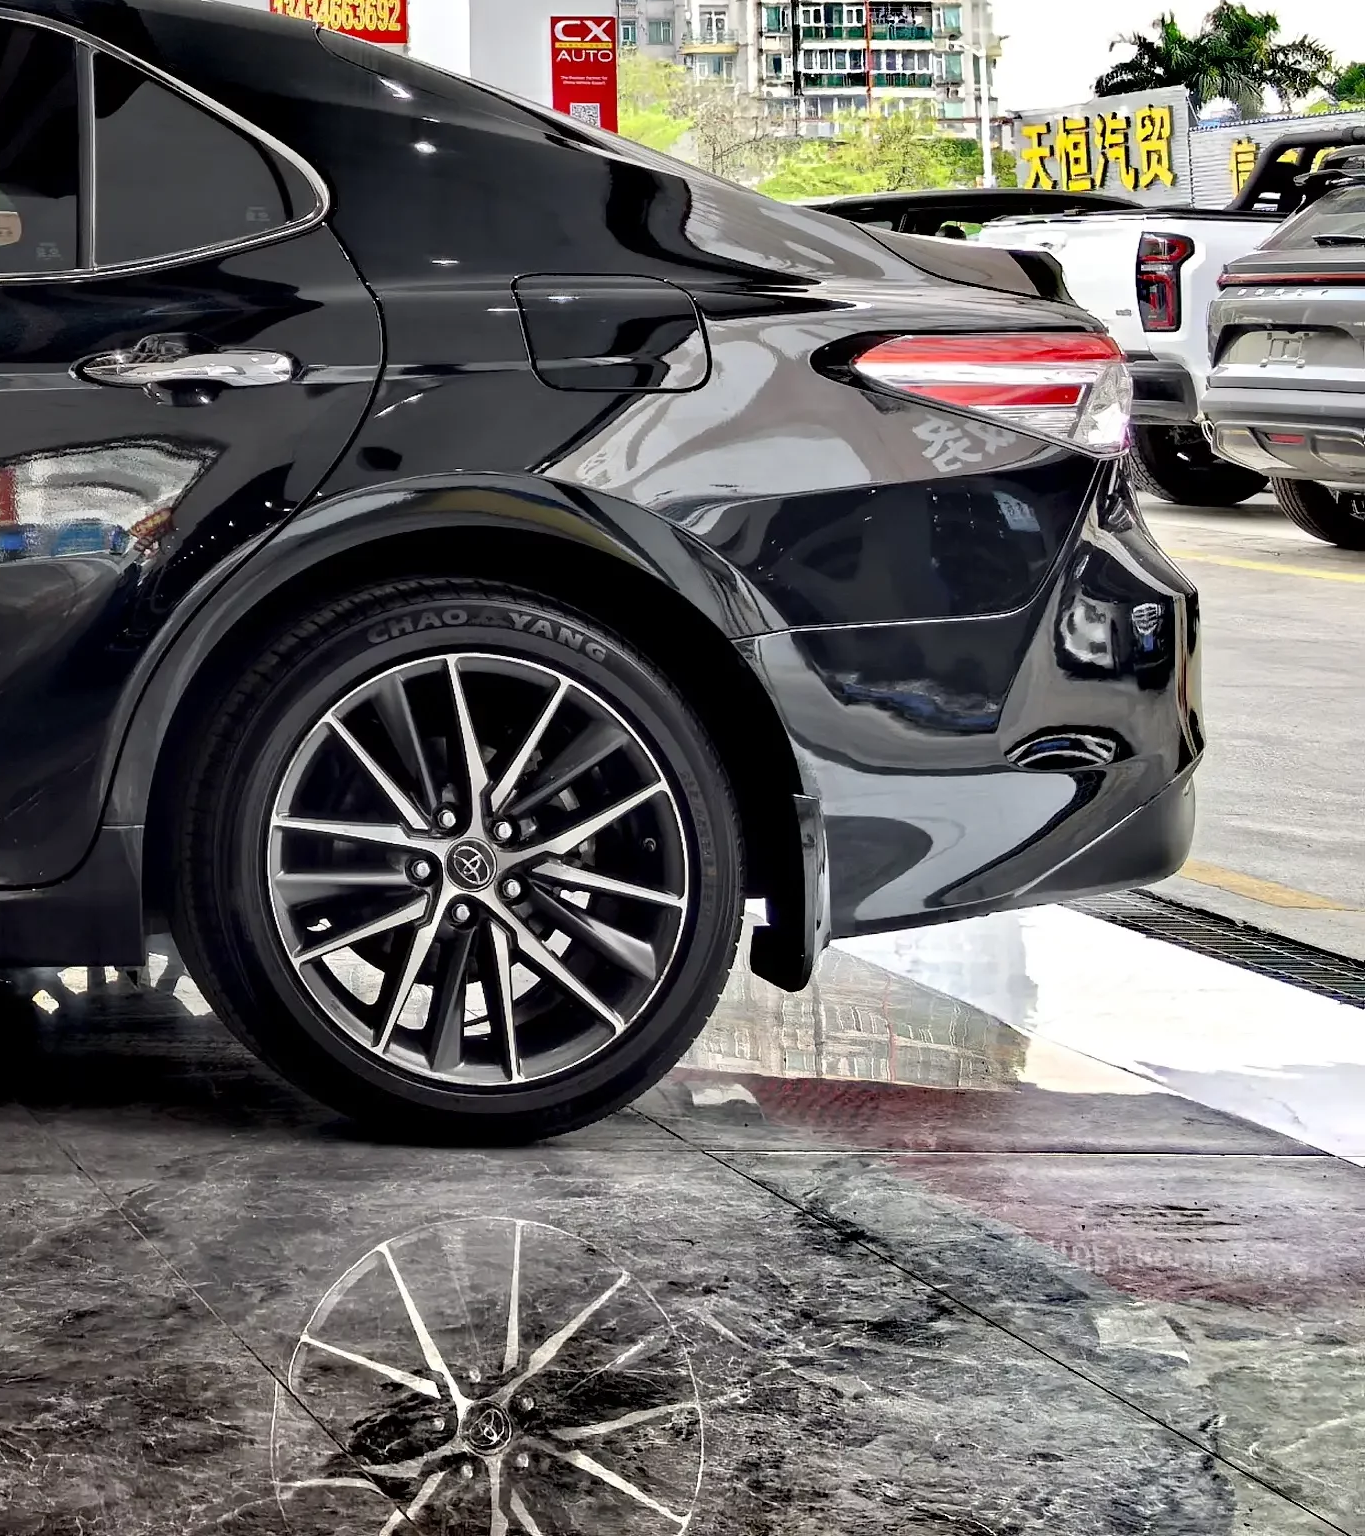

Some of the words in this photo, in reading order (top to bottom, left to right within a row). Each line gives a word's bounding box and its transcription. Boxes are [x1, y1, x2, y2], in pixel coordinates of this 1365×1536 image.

[554, 19, 612, 42] CX
[555, 49, 613, 63] AUTO
[1020, 103, 1177, 192] 天恒汽贸
[366, 609, 468, 644] CHAO
[508, 612, 607, 663] YANG
